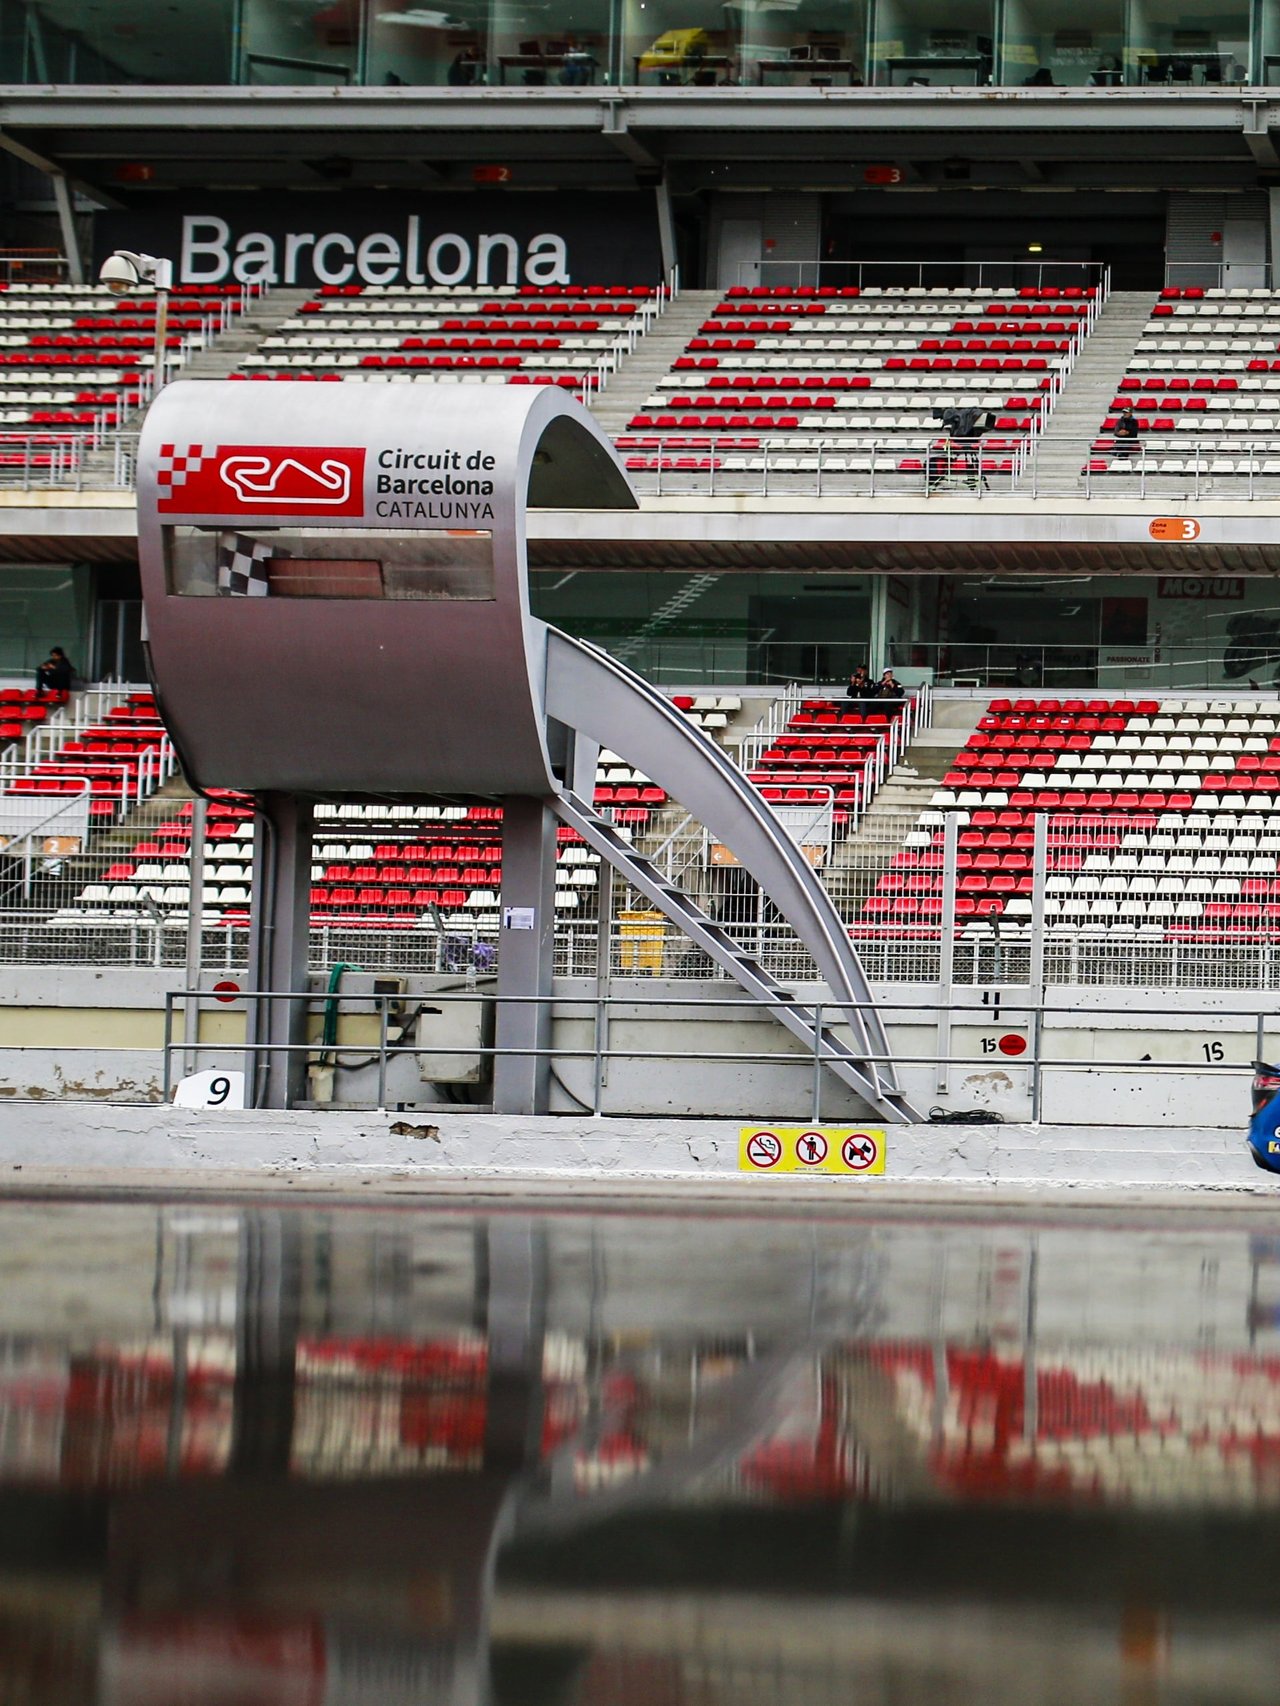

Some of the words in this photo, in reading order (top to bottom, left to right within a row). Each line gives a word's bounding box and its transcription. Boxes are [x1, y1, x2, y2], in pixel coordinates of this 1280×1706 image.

[890, 169, 901, 183] 3
[180, 214, 571, 286] Barcelona
[377, 447, 461, 471] Circuit
[466, 449, 496, 471] de
[376, 474, 494, 496] Barcelona
[375, 500, 495, 519] CATALUNYA
[1182, 519, 1196, 539] 3
[1162, 578, 1241, 597] MOTUL
[979, 1037, 997, 1054] 15
[206, 1077, 231, 1106] 9
